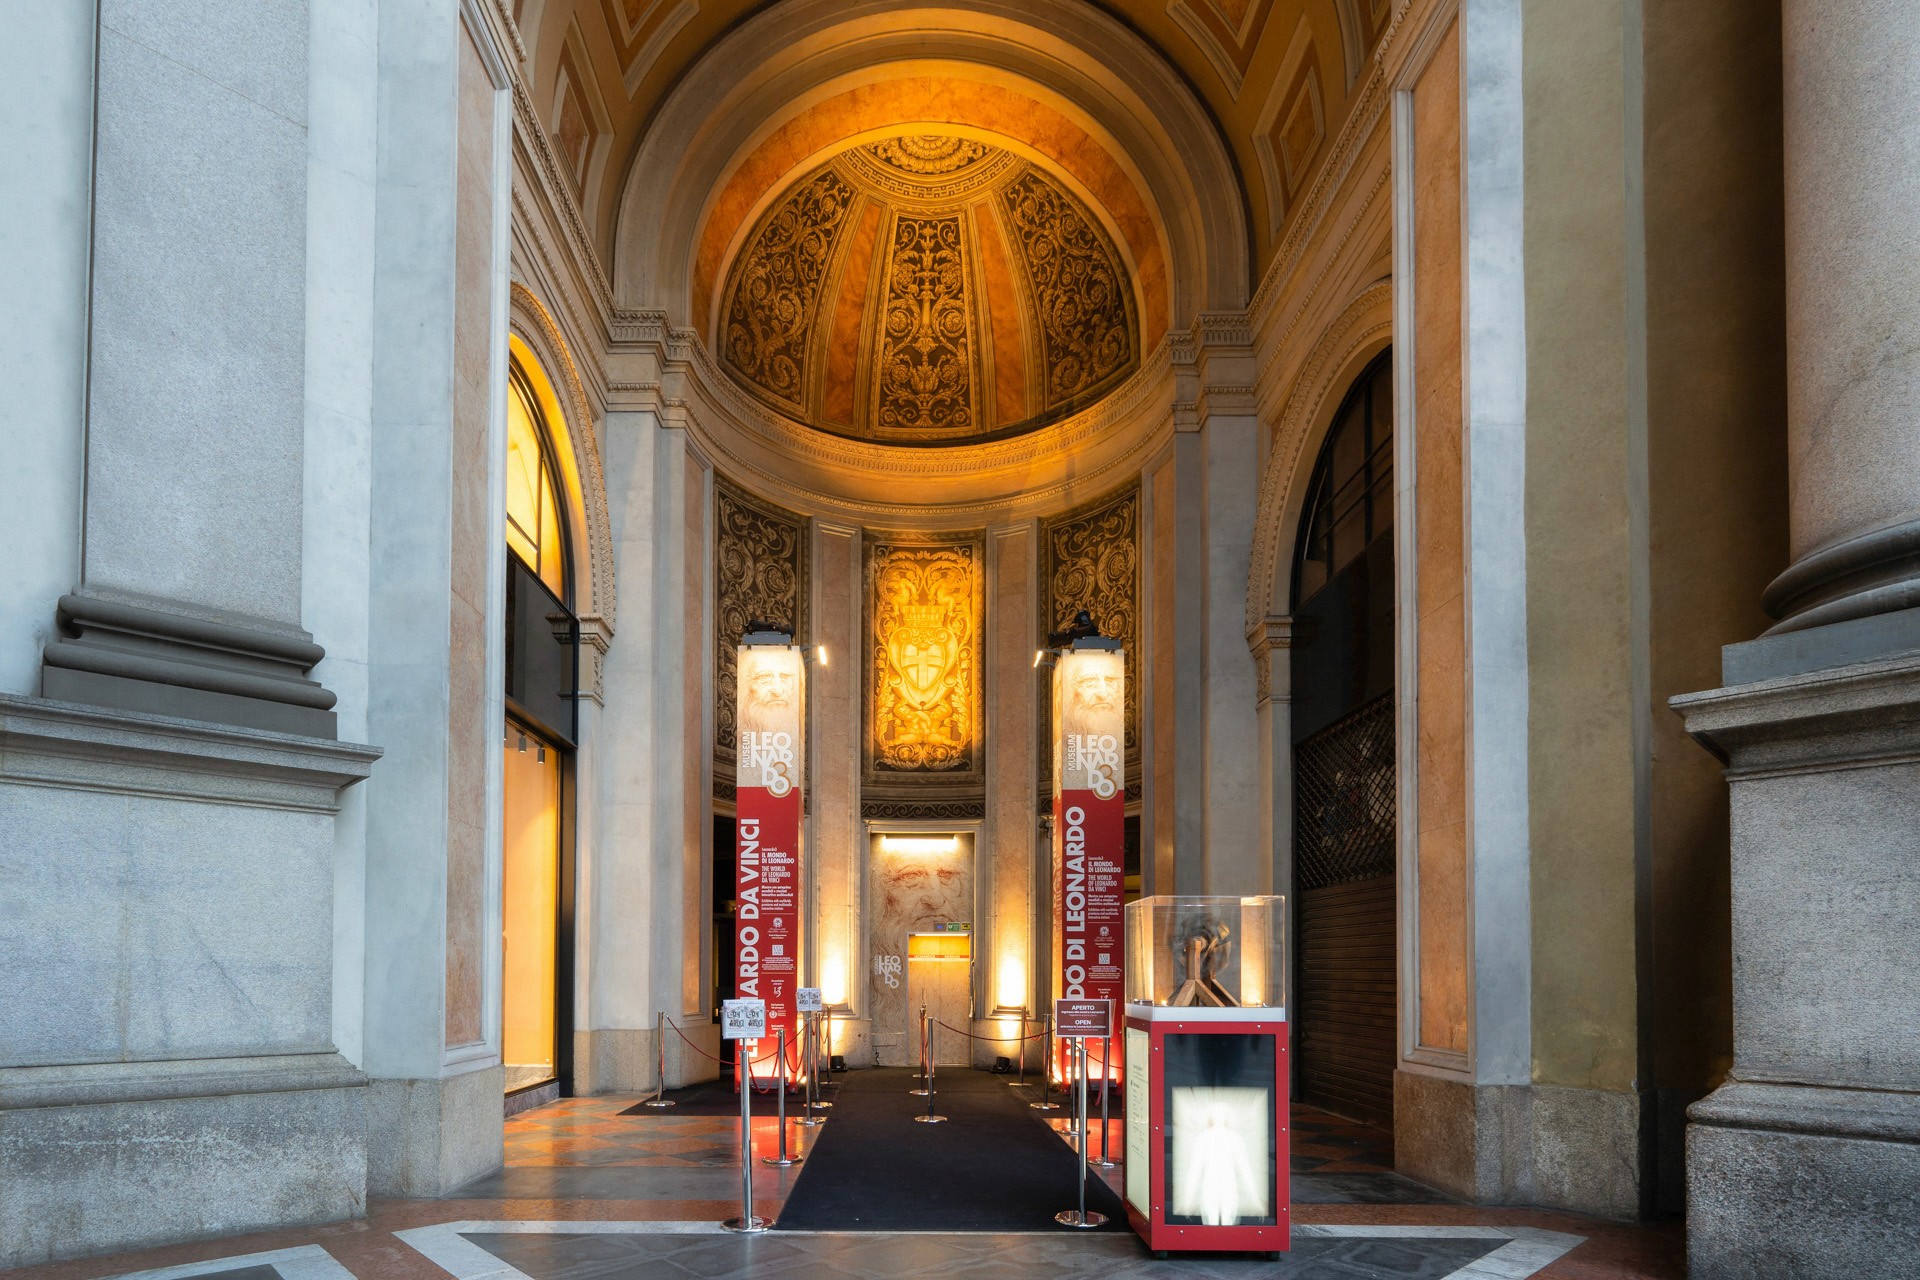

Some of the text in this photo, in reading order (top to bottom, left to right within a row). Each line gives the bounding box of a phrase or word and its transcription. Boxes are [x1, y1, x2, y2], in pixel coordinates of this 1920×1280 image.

[742, 731, 750, 767] MUSEUM
[751, 731, 792, 750] LEO
[1068, 735, 1076, 770] MUSEUM
[1076, 735, 1117, 753] LEO
[740, 818, 760, 883] VINCI
[1066, 806, 1085, 932] LEONARDO
[740, 886, 760, 920] DA
[1066, 939, 1085, 960] DI
